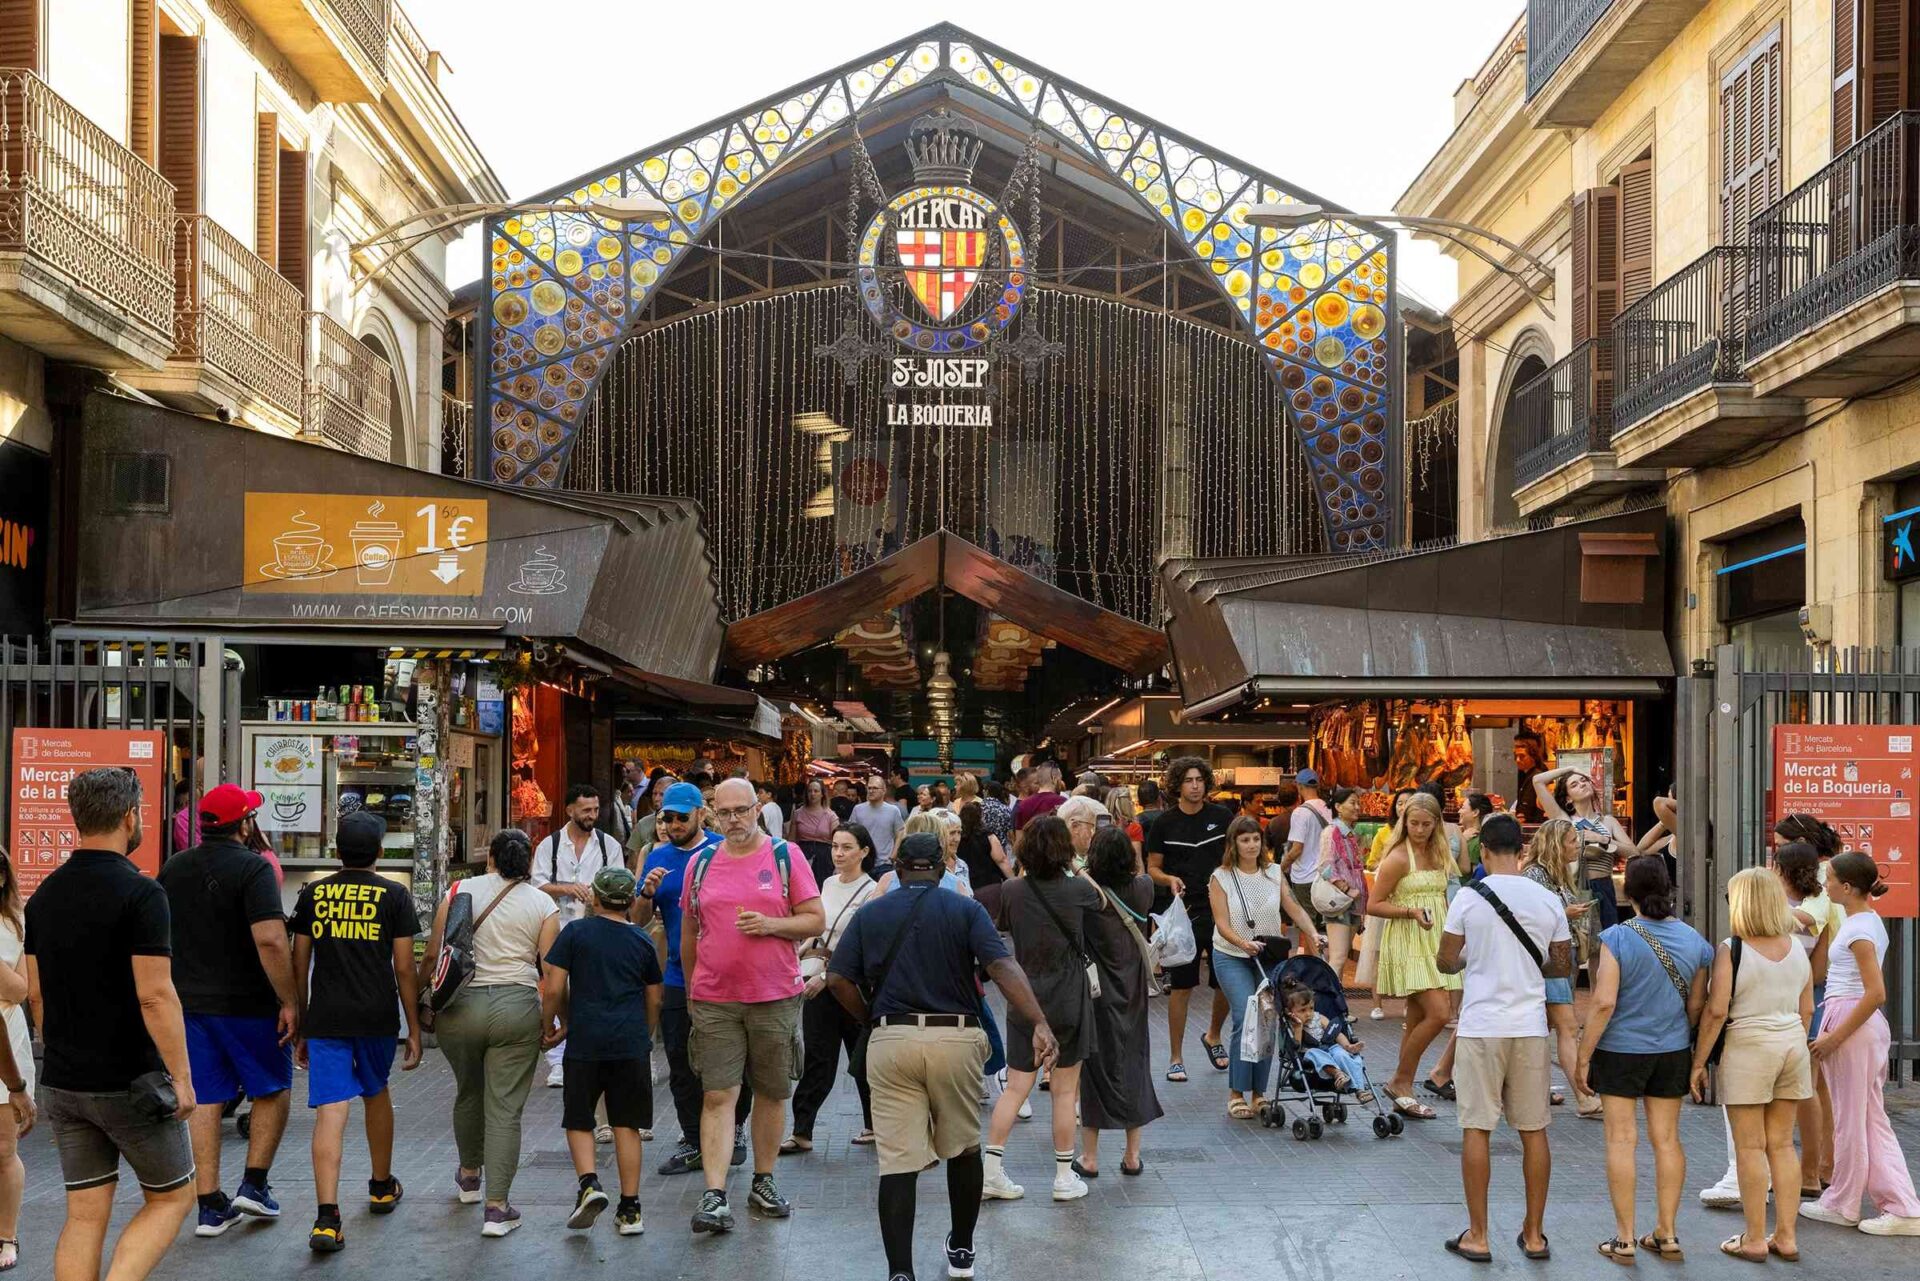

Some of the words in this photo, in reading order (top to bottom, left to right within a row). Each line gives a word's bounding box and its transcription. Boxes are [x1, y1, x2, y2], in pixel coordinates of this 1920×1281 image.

[900, 198, 986, 229] MERCAT
[914, 358, 989, 388] JOSEP
[887, 404, 908, 425] LA
[912, 404, 993, 426] BOQUERIA
[363, 552, 389, 562] Coffee
[292, 604, 341, 618] WWW
[492, 607, 533, 624] COM
[42, 740, 72, 748] Mercats
[1804, 735, 1833, 743] Mercats
[42, 750, 52, 758] de
[54, 749, 92, 758] Barcelona
[1816, 744, 1852, 753] Barcelona
[20, 767, 75, 782] Mercat
[1784, 762, 1837, 777] Mercat
[20, 785, 39, 799] de
[42, 785, 56, 799] la
[1784, 780, 1802, 793] de
[1806, 780, 1819, 793] la
[1823, 780, 1891, 796] Boqueria
[313, 883, 387, 902] SWEET
[314, 900, 377, 920] CHILD
